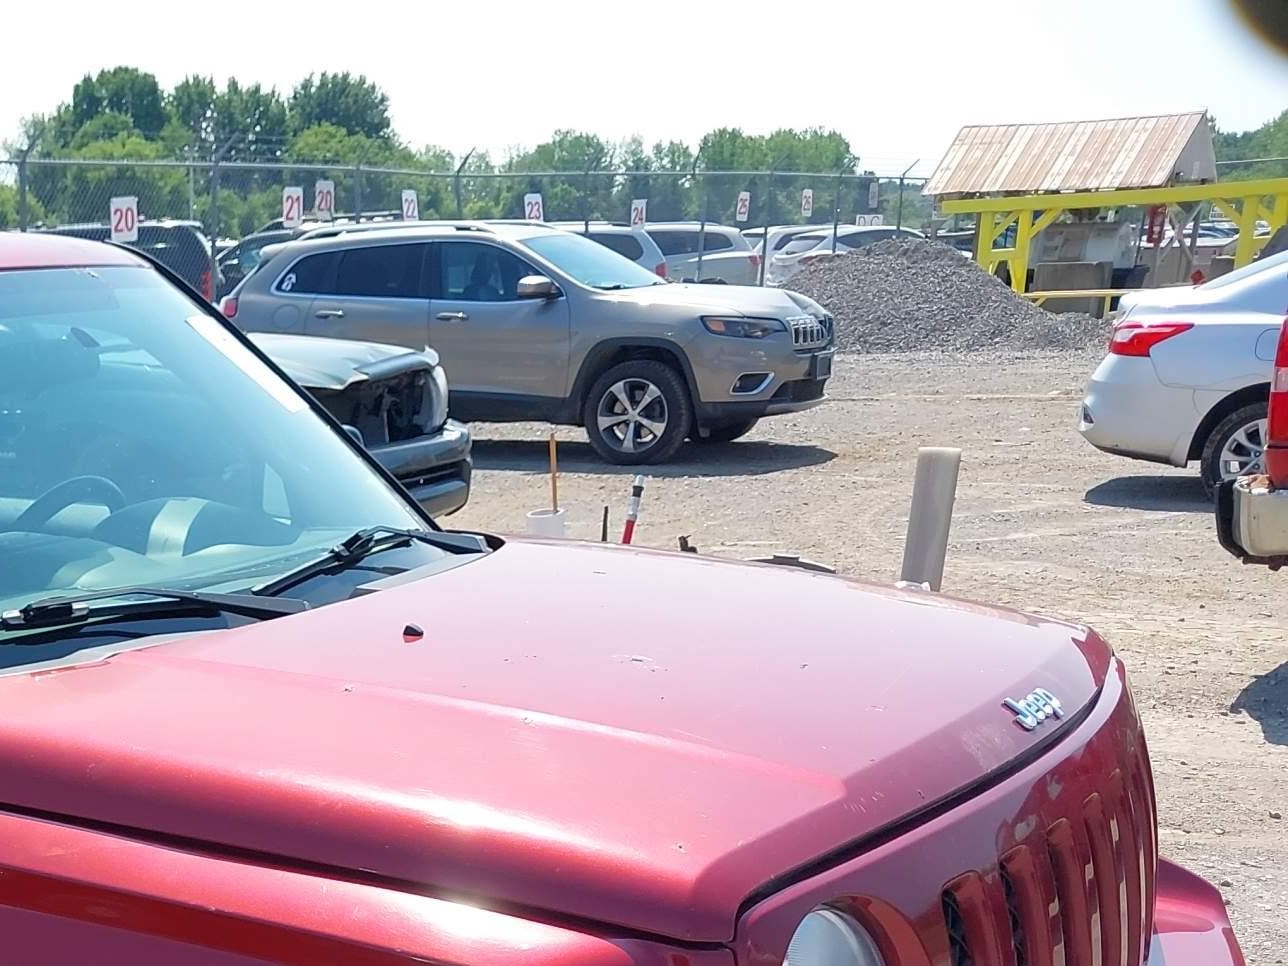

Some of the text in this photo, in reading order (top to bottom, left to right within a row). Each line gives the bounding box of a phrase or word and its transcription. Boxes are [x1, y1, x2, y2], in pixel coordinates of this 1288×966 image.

[286, 195, 301, 220] 21
[318, 190, 332, 211] 20
[404, 198, 416, 218] 22
[527, 201, 541, 220] 23
[114, 207, 135, 232] 20
[633, 206, 644, 225] 24
[1002, 687, 1064, 729] Jeep
